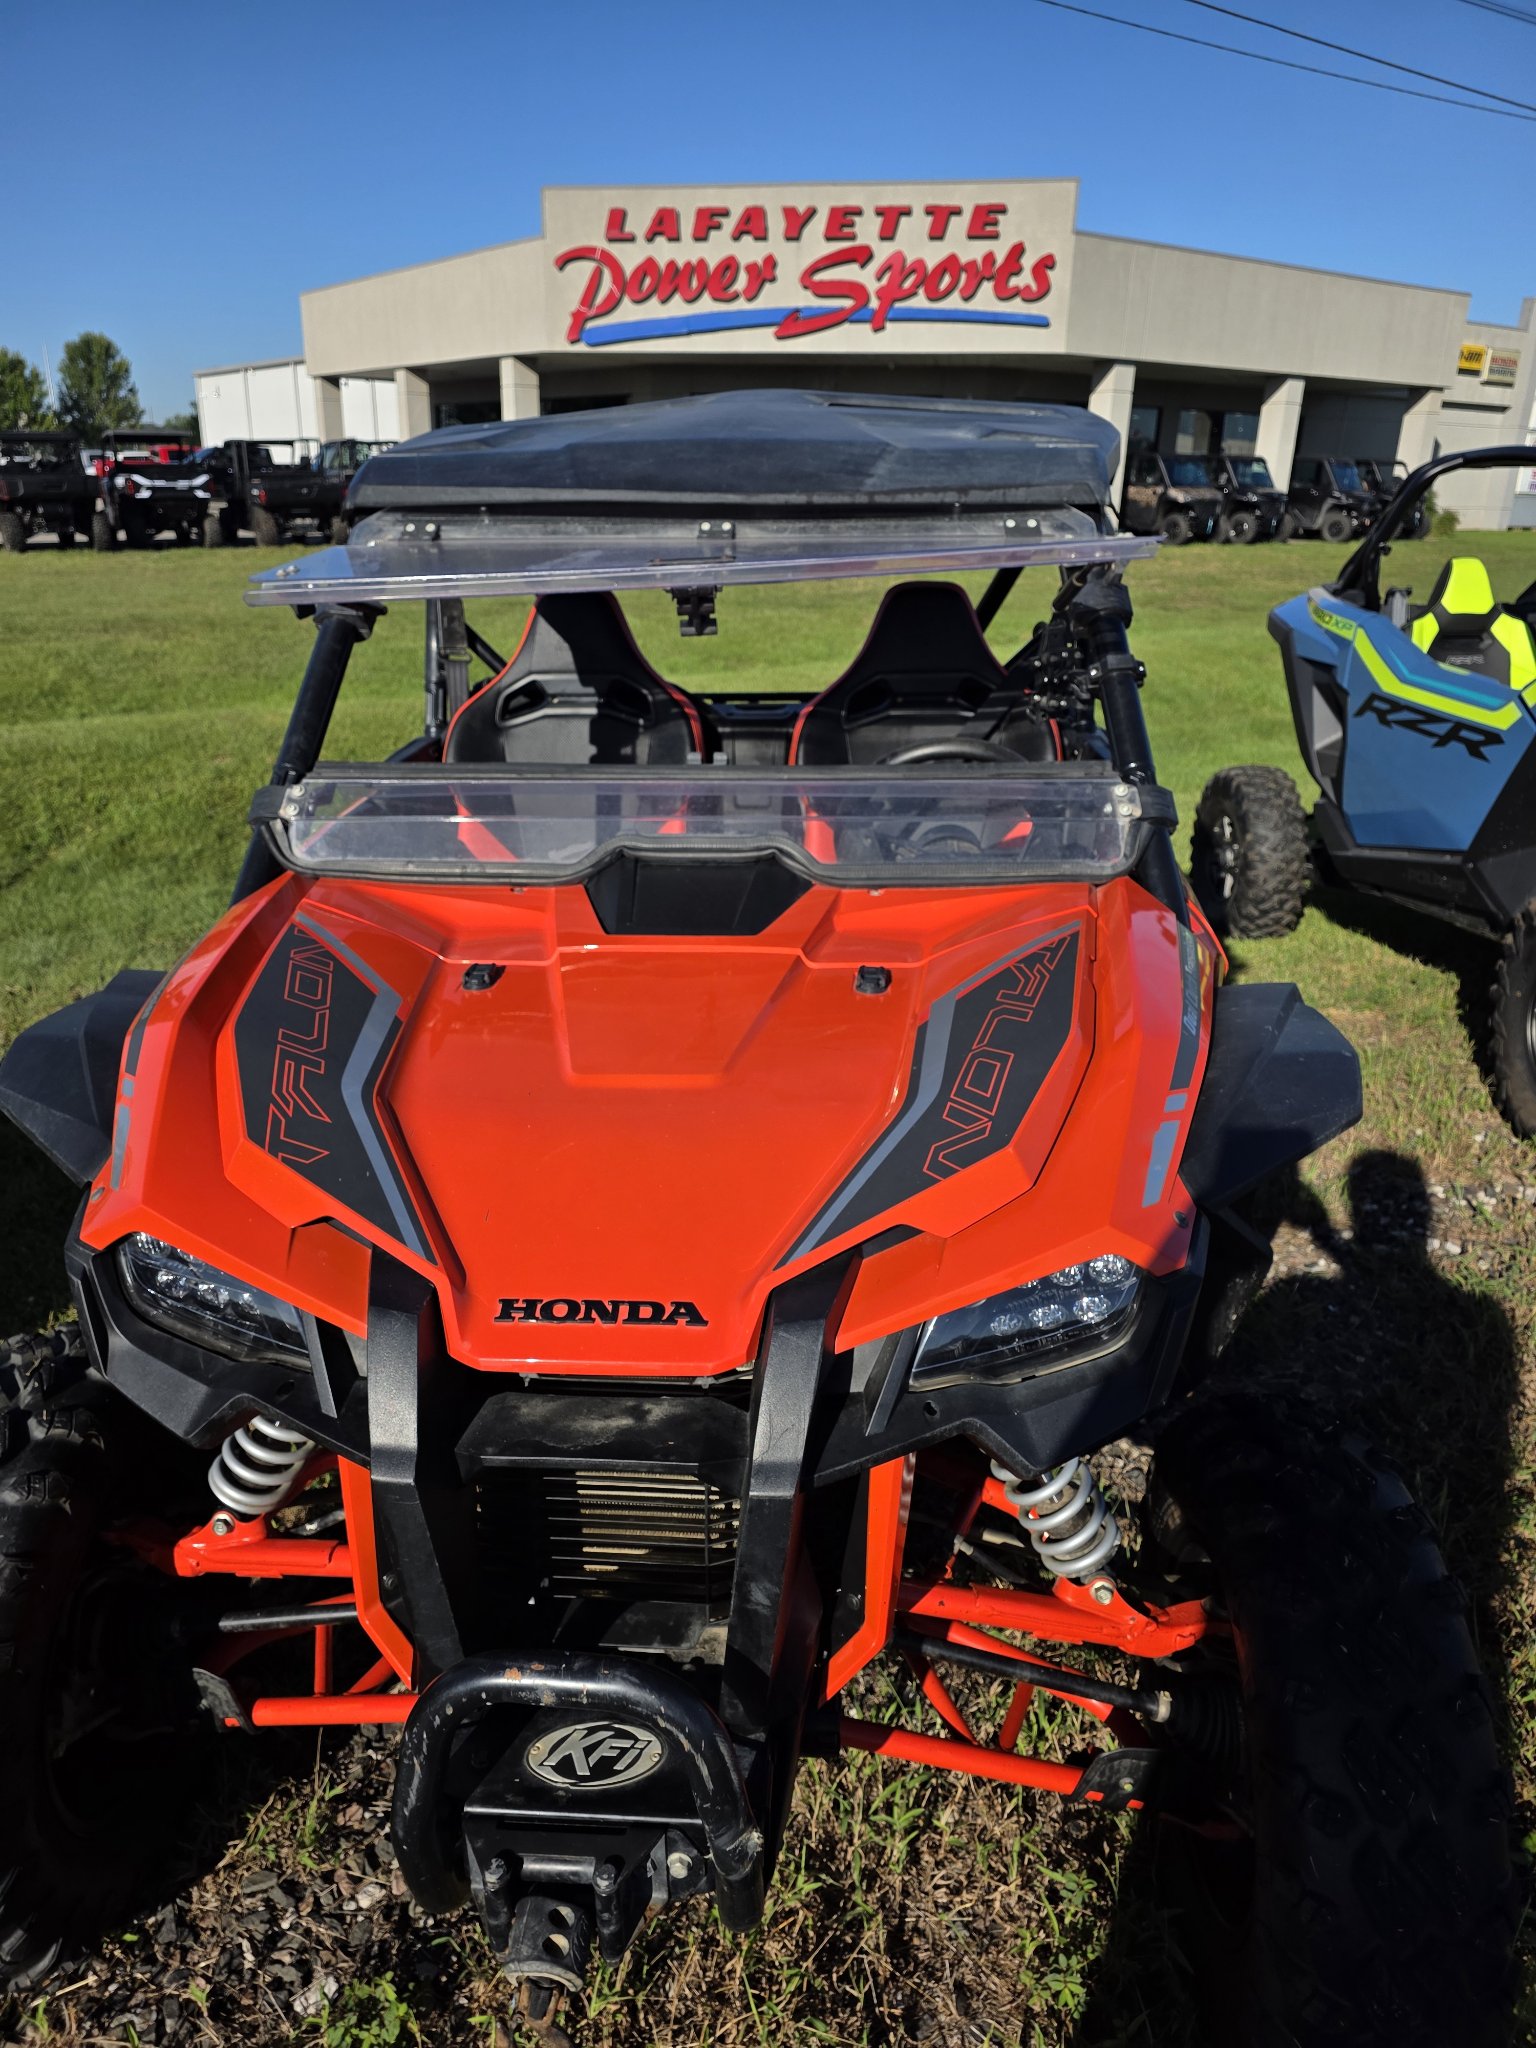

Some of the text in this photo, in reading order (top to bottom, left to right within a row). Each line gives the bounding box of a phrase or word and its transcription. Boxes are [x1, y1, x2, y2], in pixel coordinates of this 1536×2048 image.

[605, 203, 1008, 242] LAFAYETTE
[554, 241, 1057, 343] Power Sports
[1353, 691, 1505, 763] RZR
[265, 926, 334, 1164] TALON
[923, 936, 1071, 1181] TALON
[494, 1298, 709, 1326] HONDA
